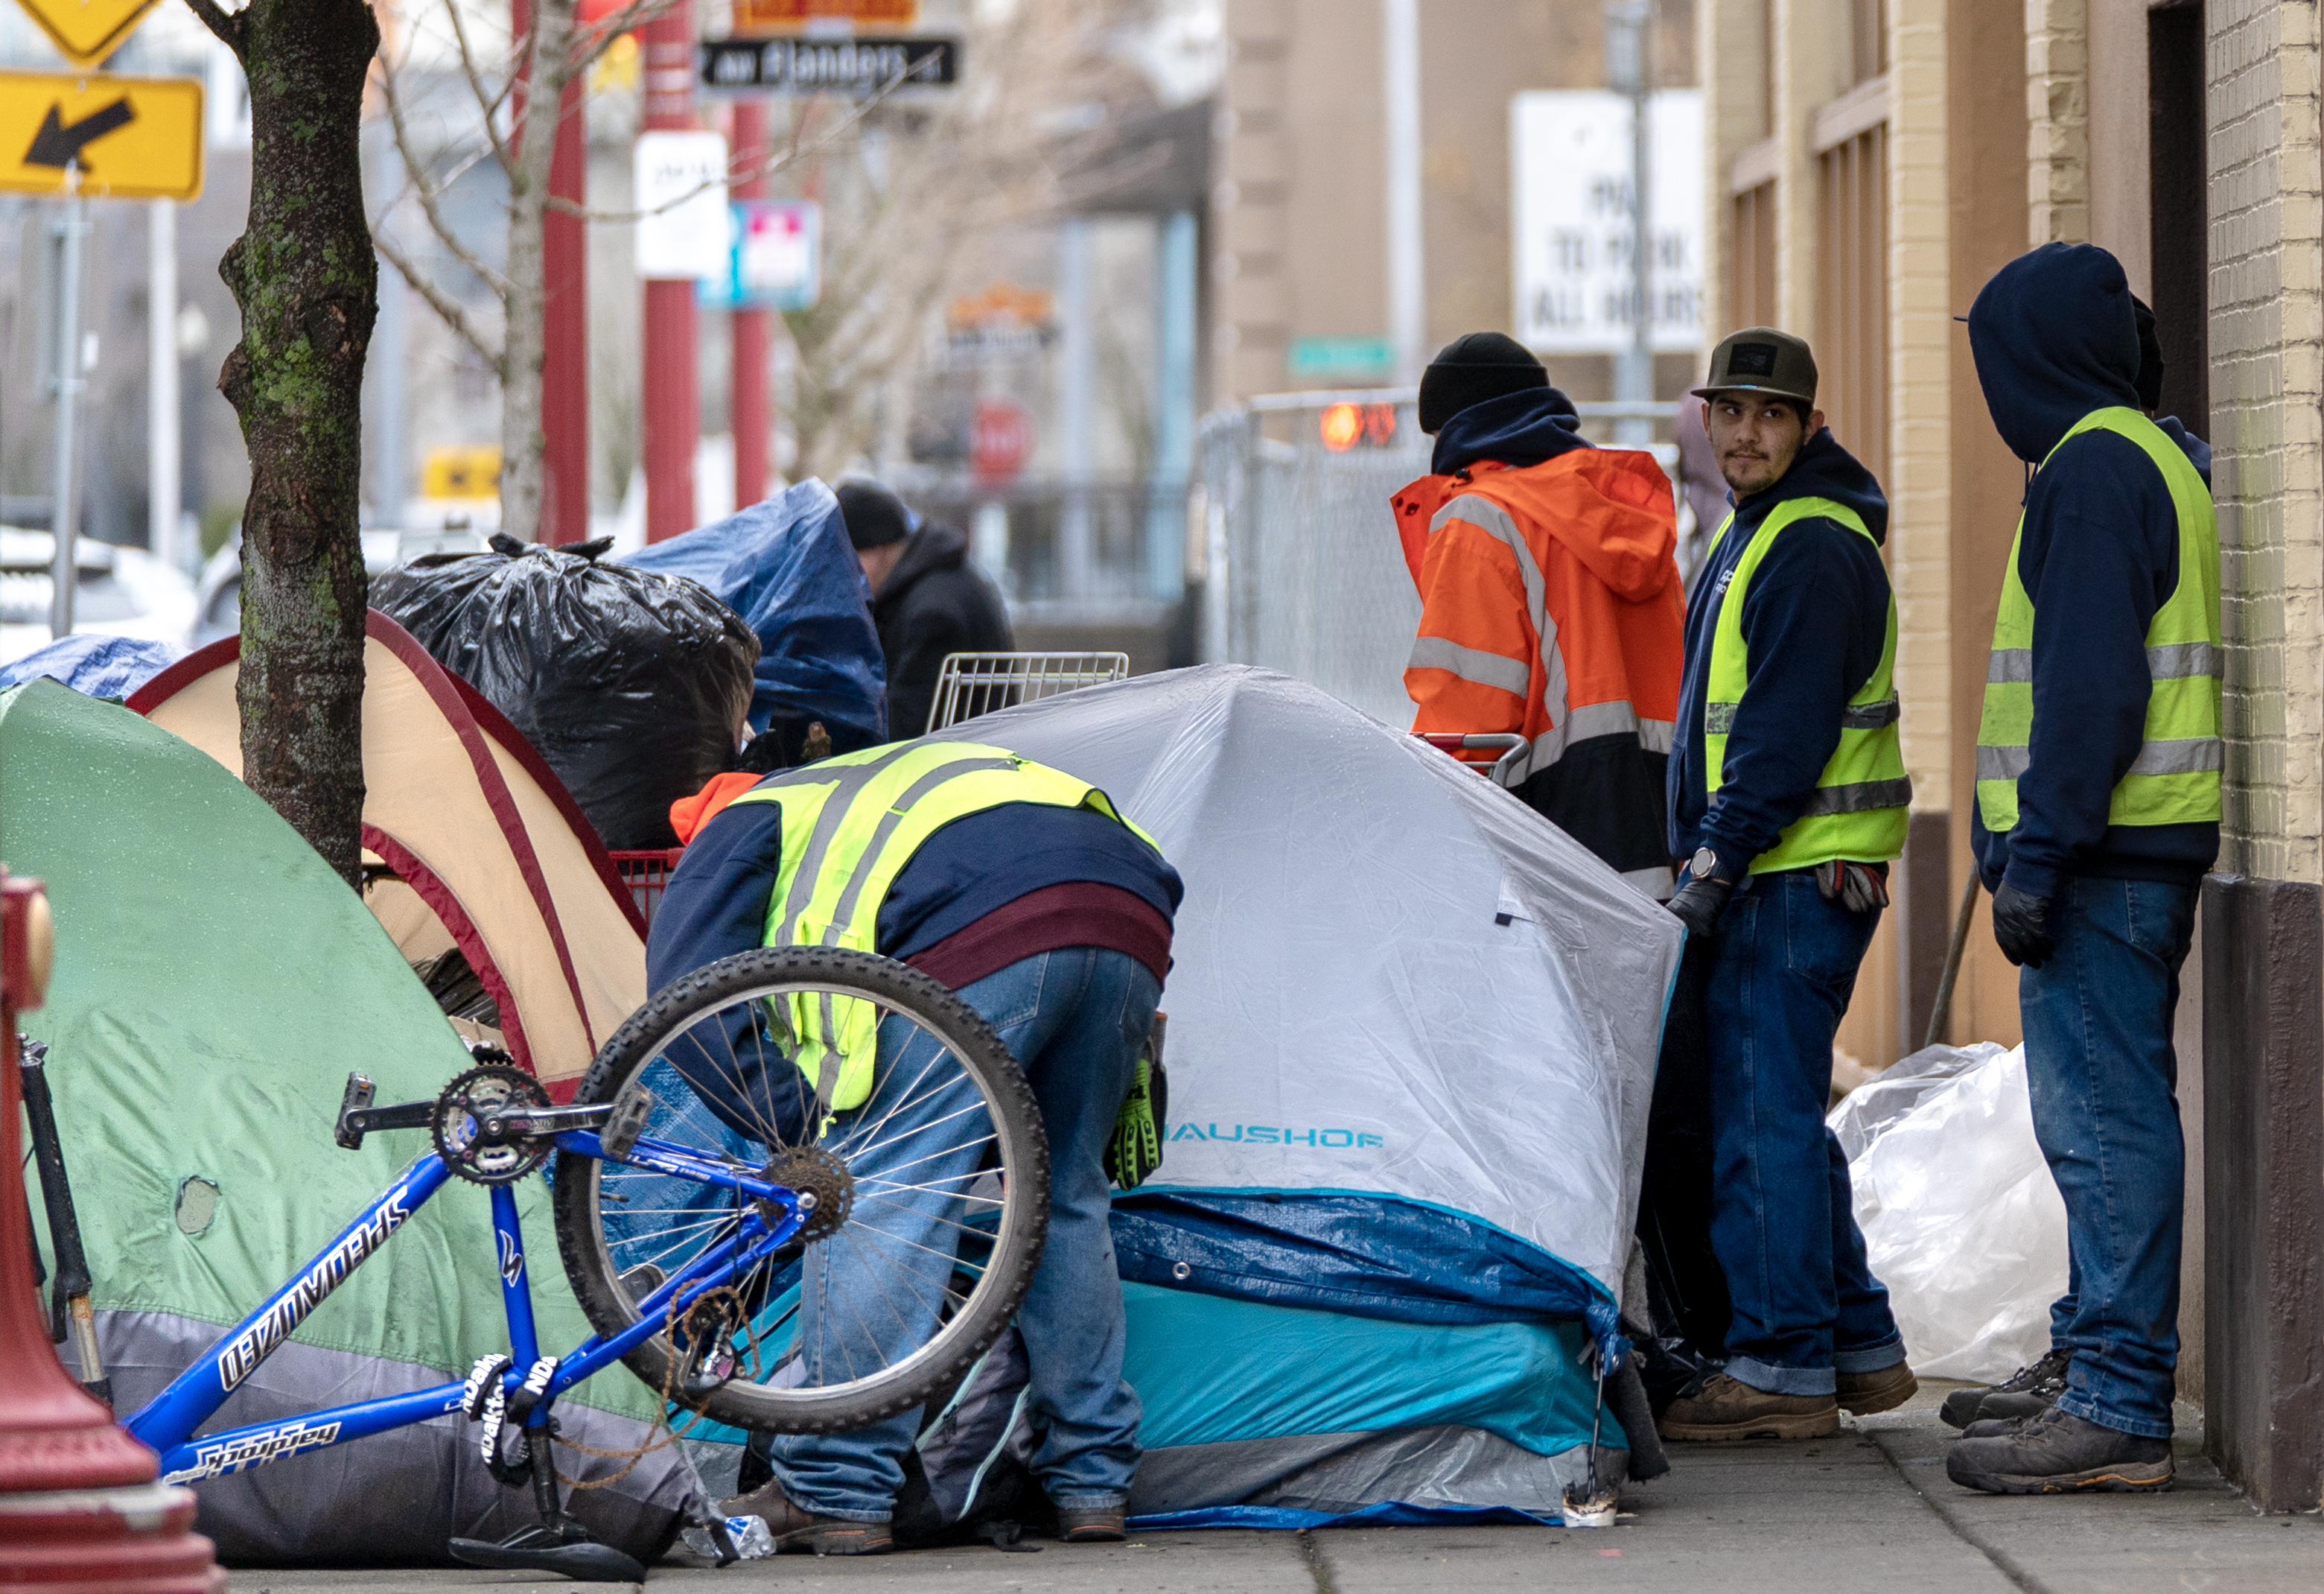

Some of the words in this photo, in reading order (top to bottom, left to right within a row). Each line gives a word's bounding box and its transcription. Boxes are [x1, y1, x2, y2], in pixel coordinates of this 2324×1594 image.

[1163, 1123, 1384, 1149] AUSHOF
[218, 1185, 410, 1392] SPECIALIZED
[206, 1422, 341, 1470] hardrock
